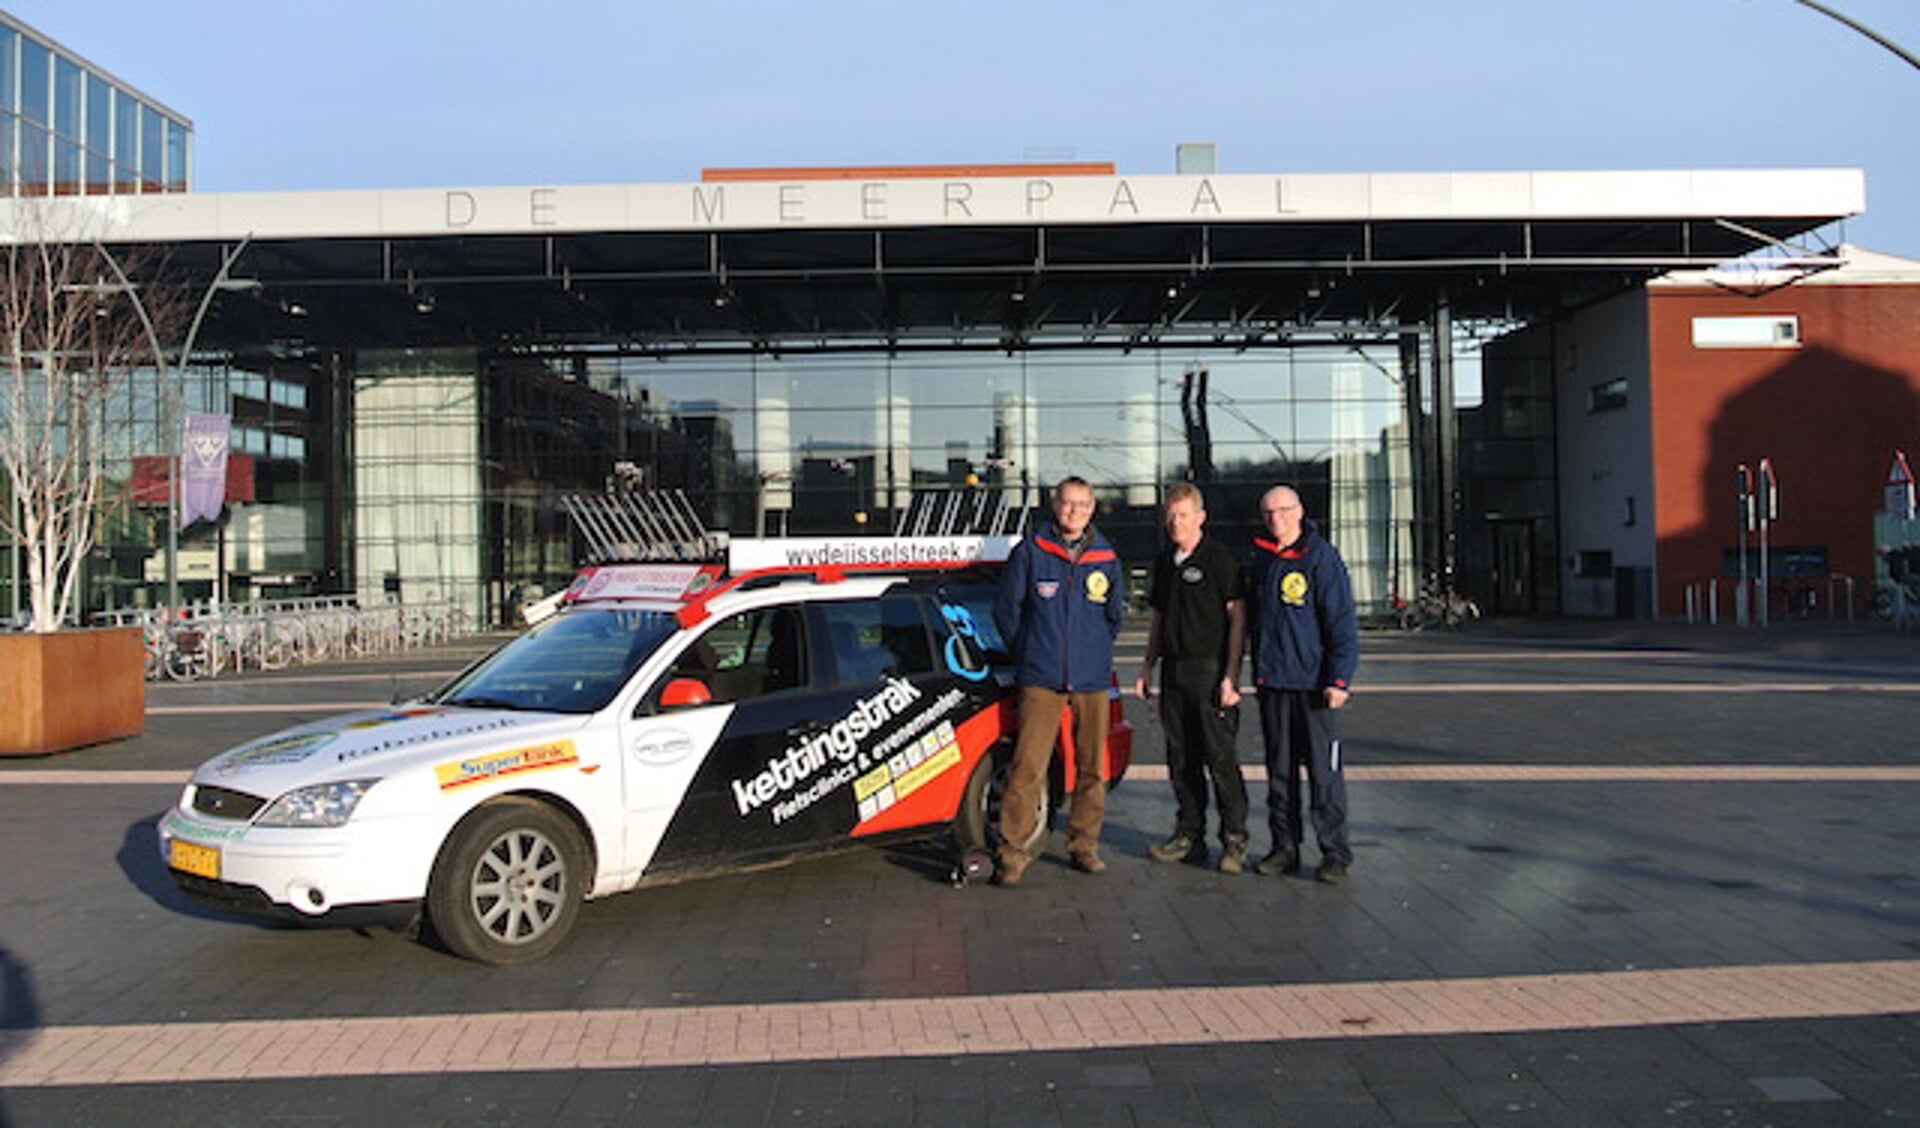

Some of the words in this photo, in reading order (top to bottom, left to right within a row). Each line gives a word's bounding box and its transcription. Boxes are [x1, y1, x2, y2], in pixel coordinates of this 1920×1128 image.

[445, 188, 557, 228] DE
[692, 178, 1297, 224] MEERPAAL
[338, 718, 517, 762] Rabobank
[732, 677, 922, 816] kettingstrak
